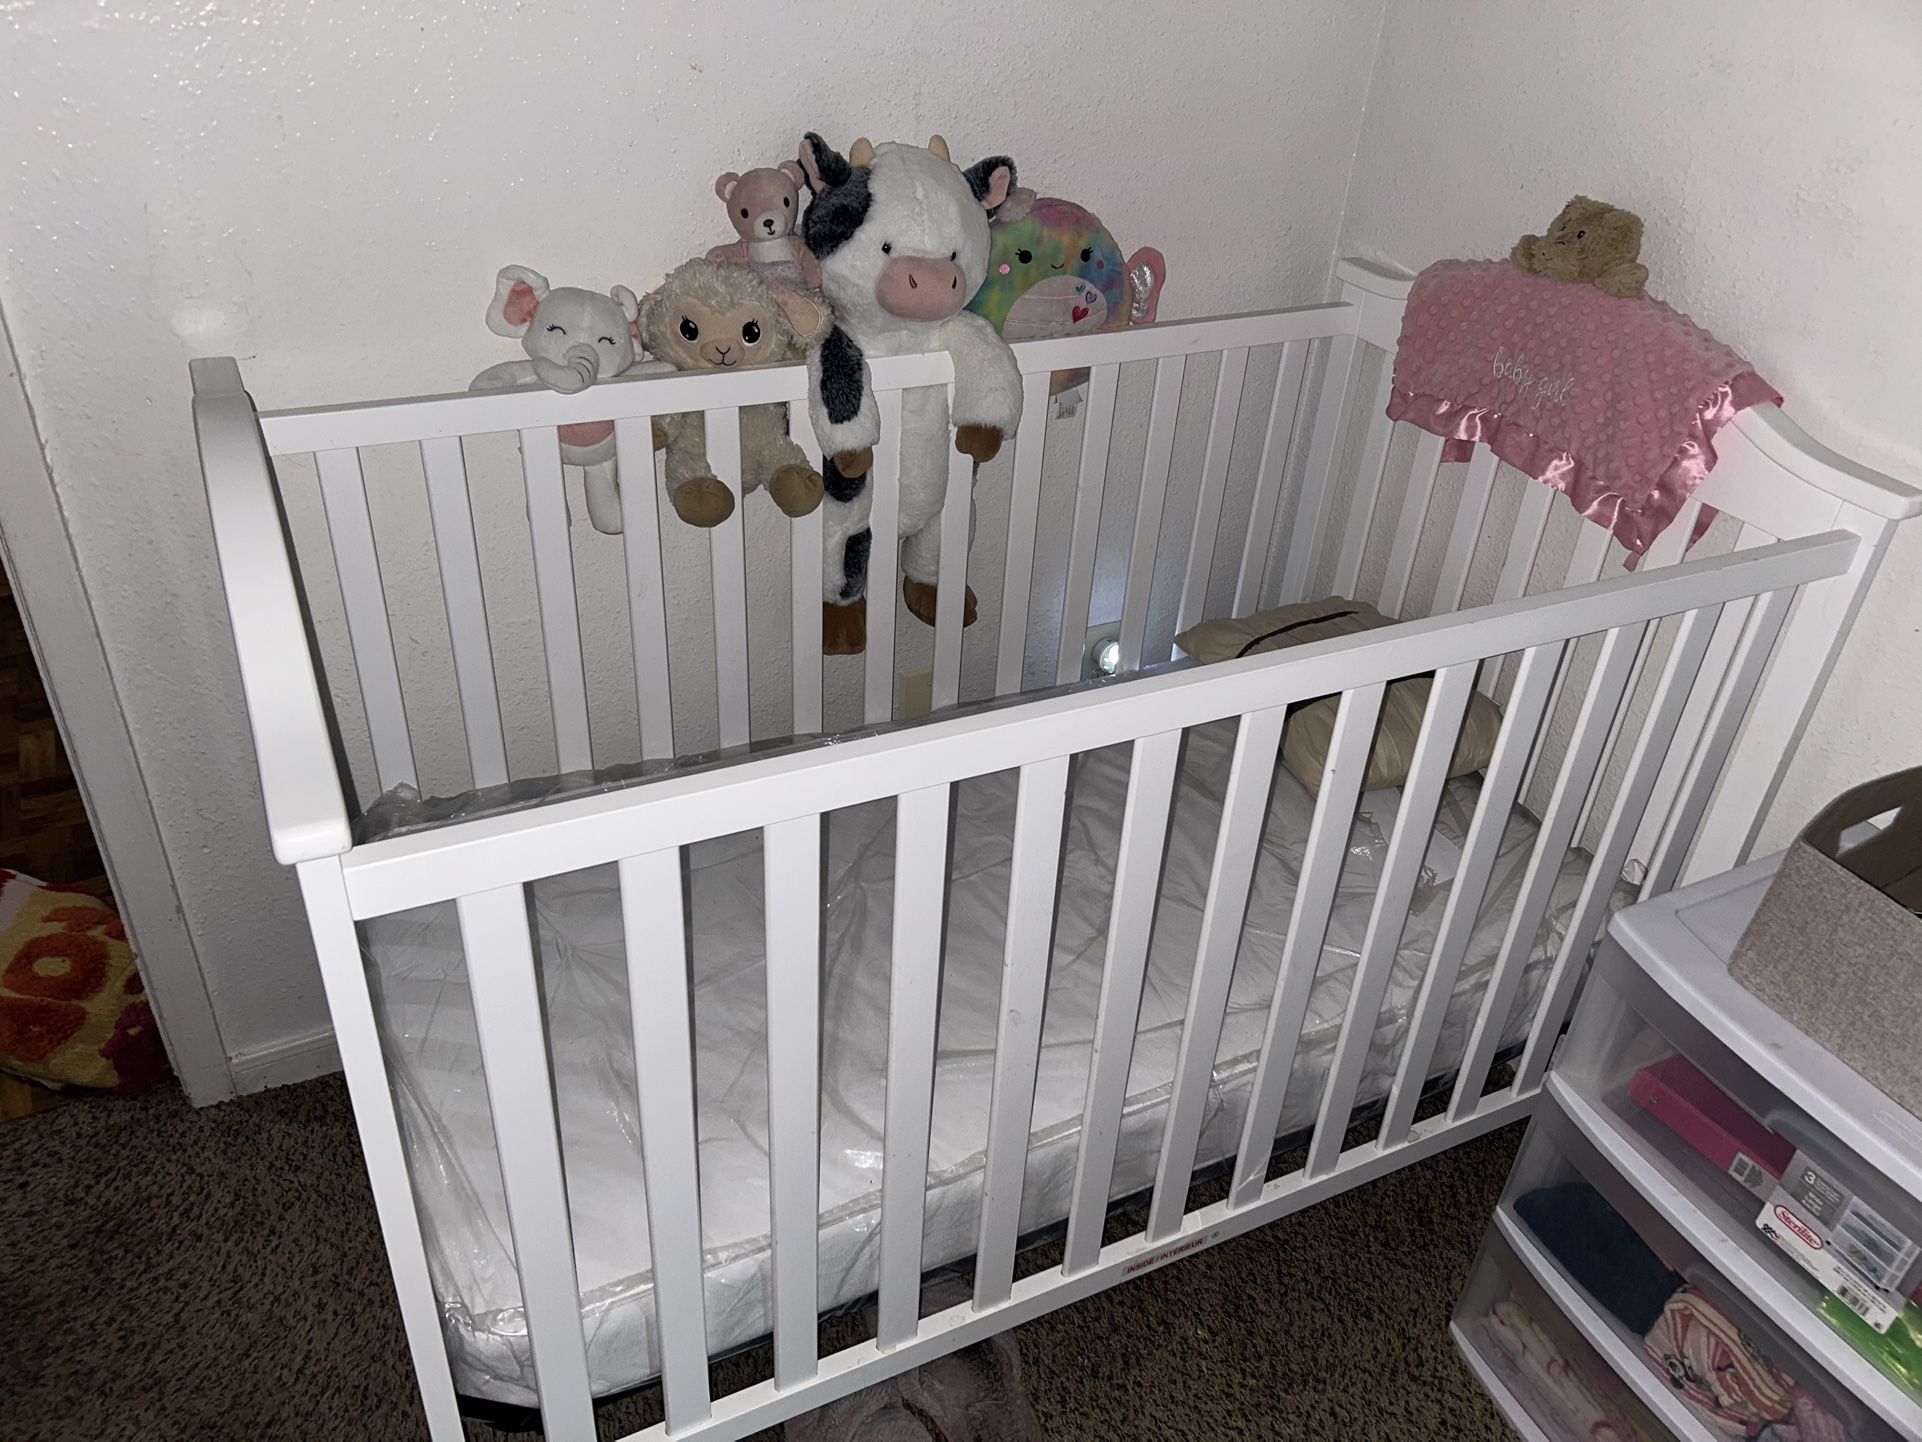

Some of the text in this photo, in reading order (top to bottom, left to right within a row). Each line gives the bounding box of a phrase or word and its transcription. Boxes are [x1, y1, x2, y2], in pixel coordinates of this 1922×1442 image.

[1493, 346, 1575, 409] baby girl
[1804, 1171, 1816, 1185] 3
[1127, 1257, 1154, 1274] INSIDE
